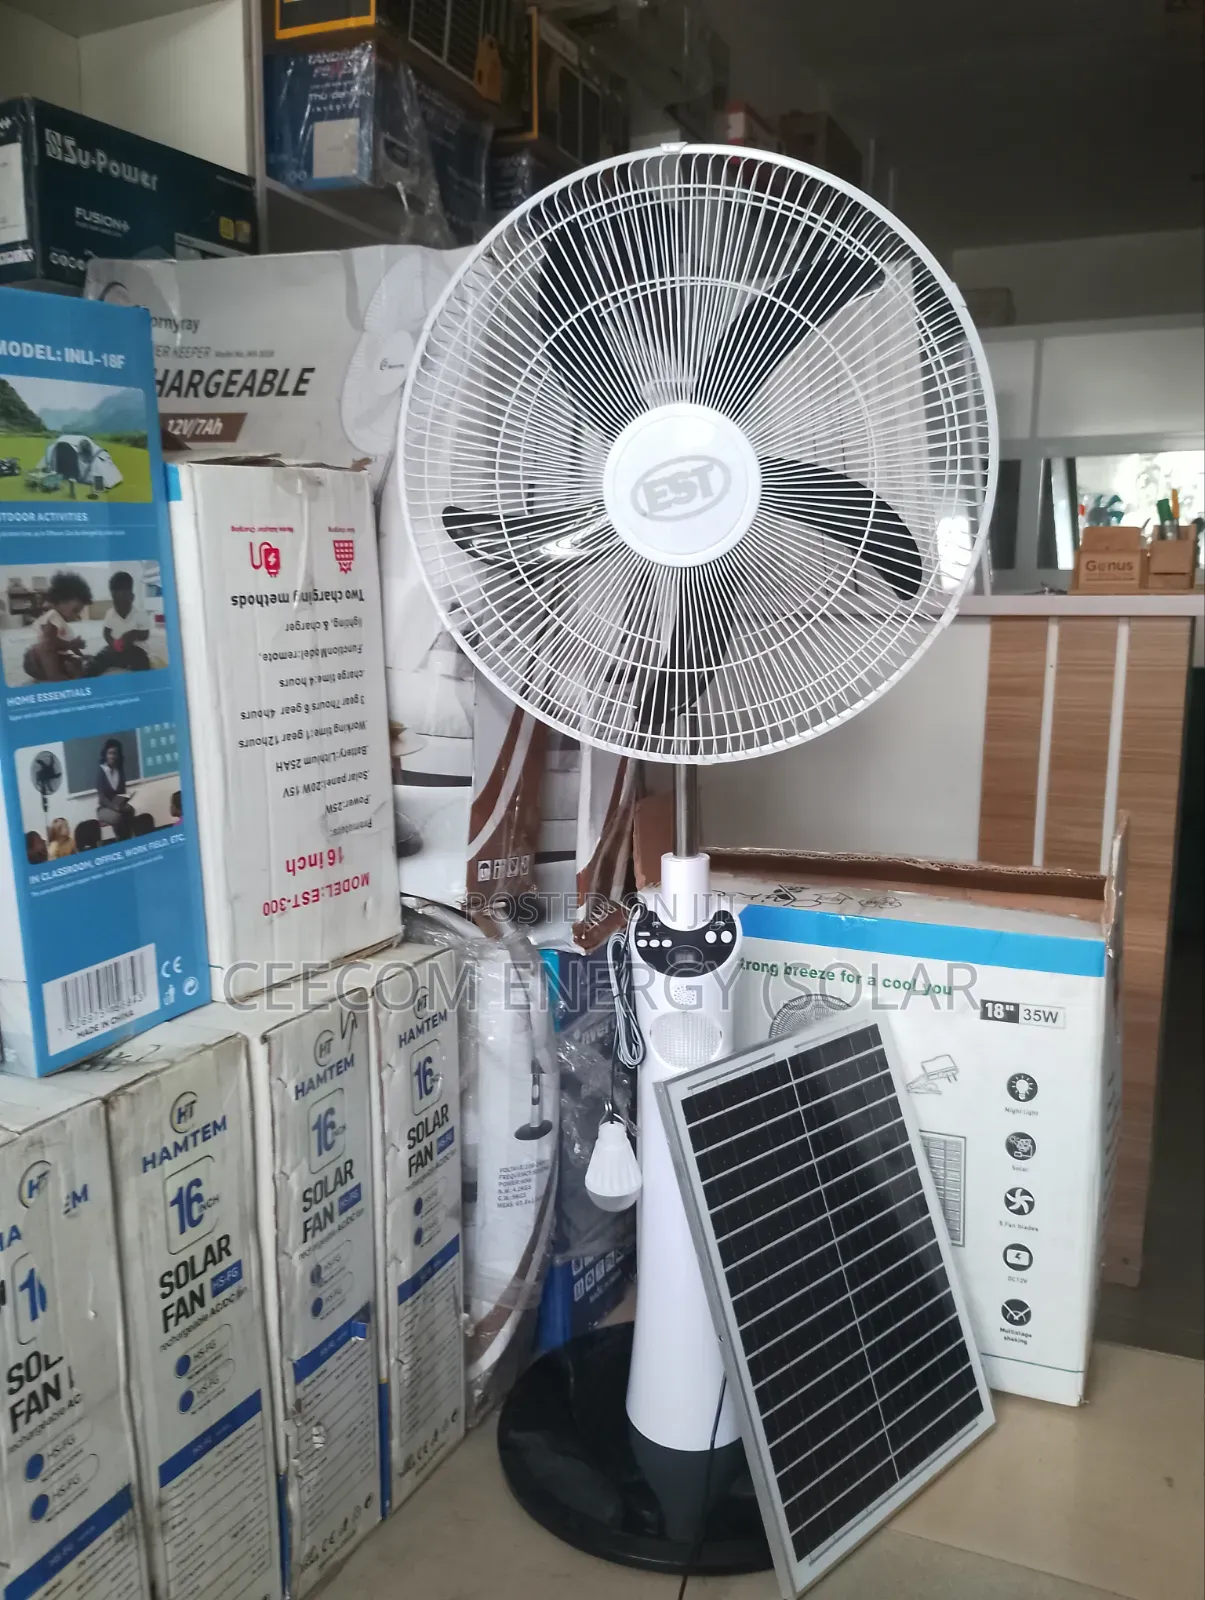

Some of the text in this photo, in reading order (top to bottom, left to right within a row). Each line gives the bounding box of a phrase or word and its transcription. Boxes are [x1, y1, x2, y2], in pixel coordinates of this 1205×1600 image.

[154, 367, 315, 399] HARGEABLE
[167, 417, 223, 436] 12V/7Ah
[643, 462, 715, 515] EST
[0, 512, 36, 521] TDOOR
[231, 593, 289, 609] methods
[345, 589, 364, 602] Two
[285, 618, 321, 633] charger
[37, 687, 92, 703] ESSENTIALS
[278, 678, 307, 689] hours
[240, 709, 276, 721] 4hours
[280, 704, 302, 717] gear
[238, 735, 279, 750] 12hours
[282, 730, 304, 744] gear
[276, 757, 302, 773] 25AH
[286, 846, 345, 877] 16 inch
[740, 957, 952, 996] trong breeze for a cool you
[399, 1008, 447, 1049] HAMTEM
[985, 1002, 1059, 1024] 18" 35W
[294, 1053, 354, 1101] HAMTEM
[414, 1056, 433, 1101] 16
[311, 1107, 336, 1157] 16
[407, 1103, 450, 1151] SOLAR
[142, 1115, 228, 1174] HAMTEM
[408, 1142, 433, 1179] FAN
[302, 1158, 355, 1214] SOLAR
[169, 1178, 204, 1235] 16
[302, 1202, 334, 1244] FAN
[159, 1233, 232, 1300] SOLAR
[162, 1282, 206, 1334] FAN
[9, 1372, 62, 1435] FAN
